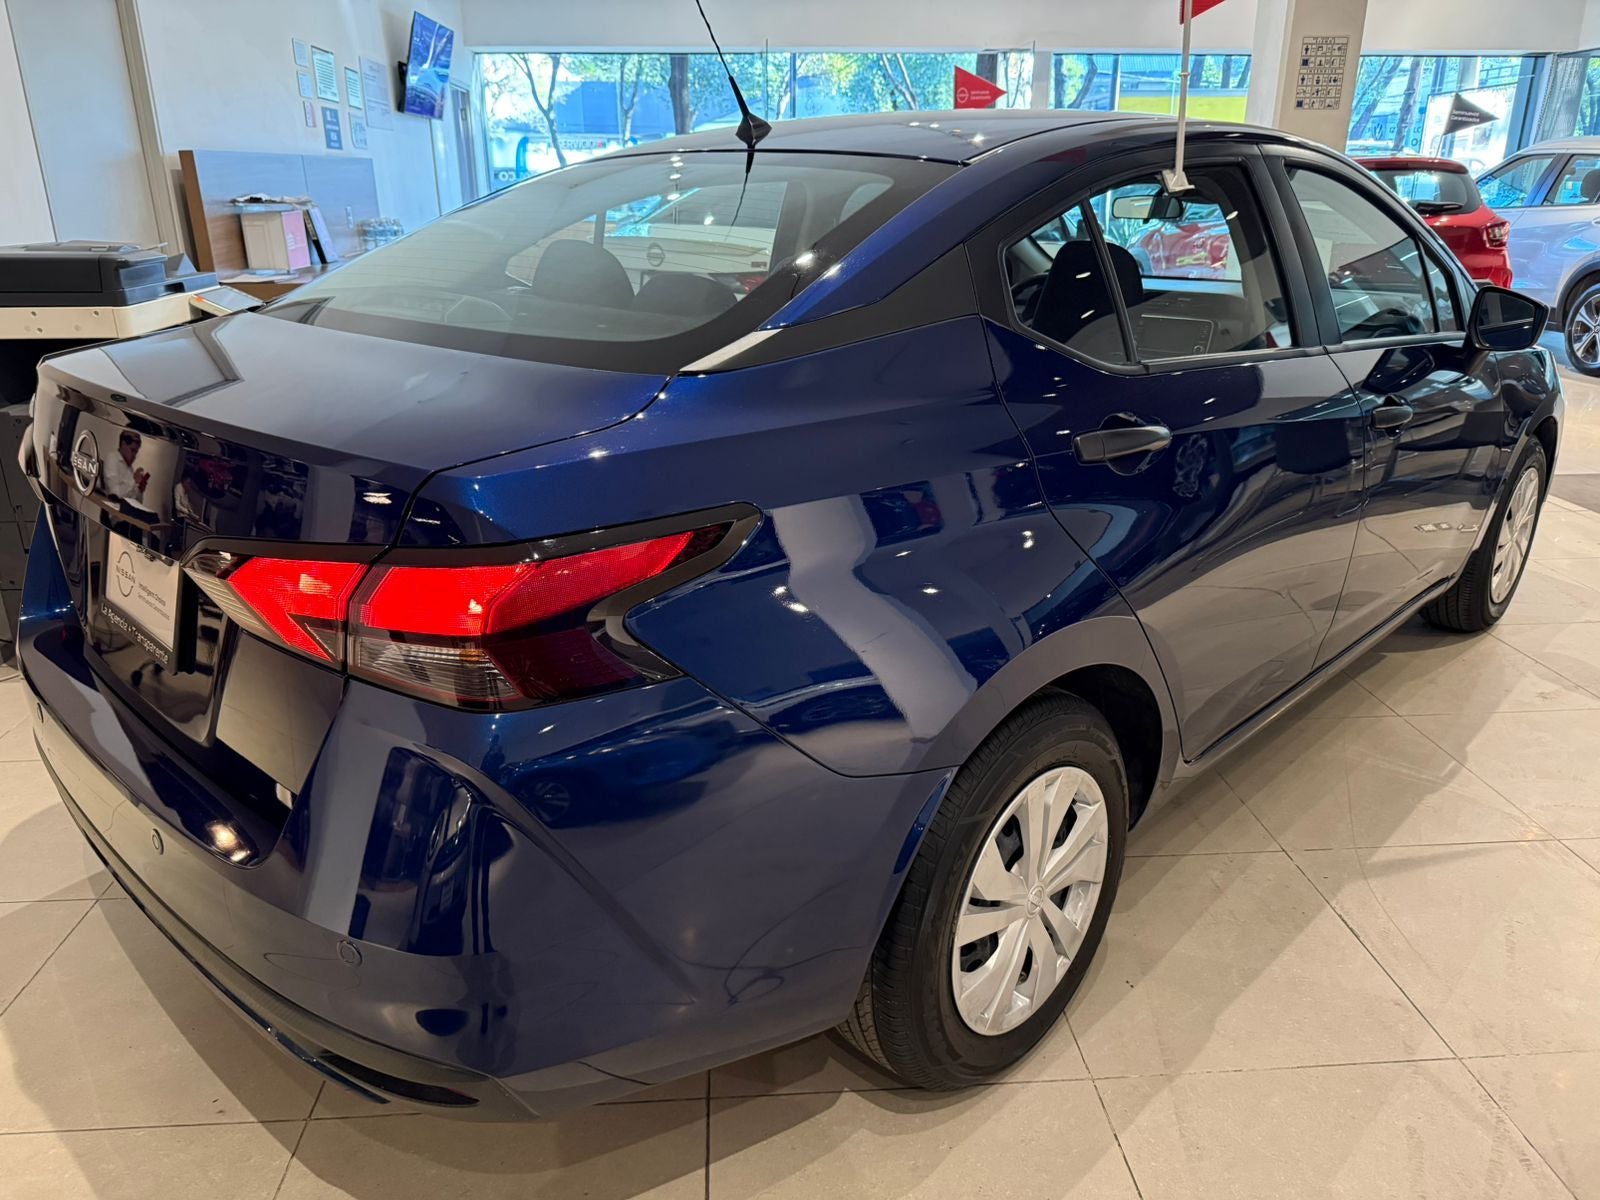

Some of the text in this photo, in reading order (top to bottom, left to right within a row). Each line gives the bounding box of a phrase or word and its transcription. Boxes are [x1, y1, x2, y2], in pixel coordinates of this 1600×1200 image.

[72, 452, 98, 474] SSAN
[116, 564, 136, 584] NISSAN
[101, 602, 108, 615] La
[108, 608, 128, 631] Agencia
[131, 626, 169, 664] Transparente
